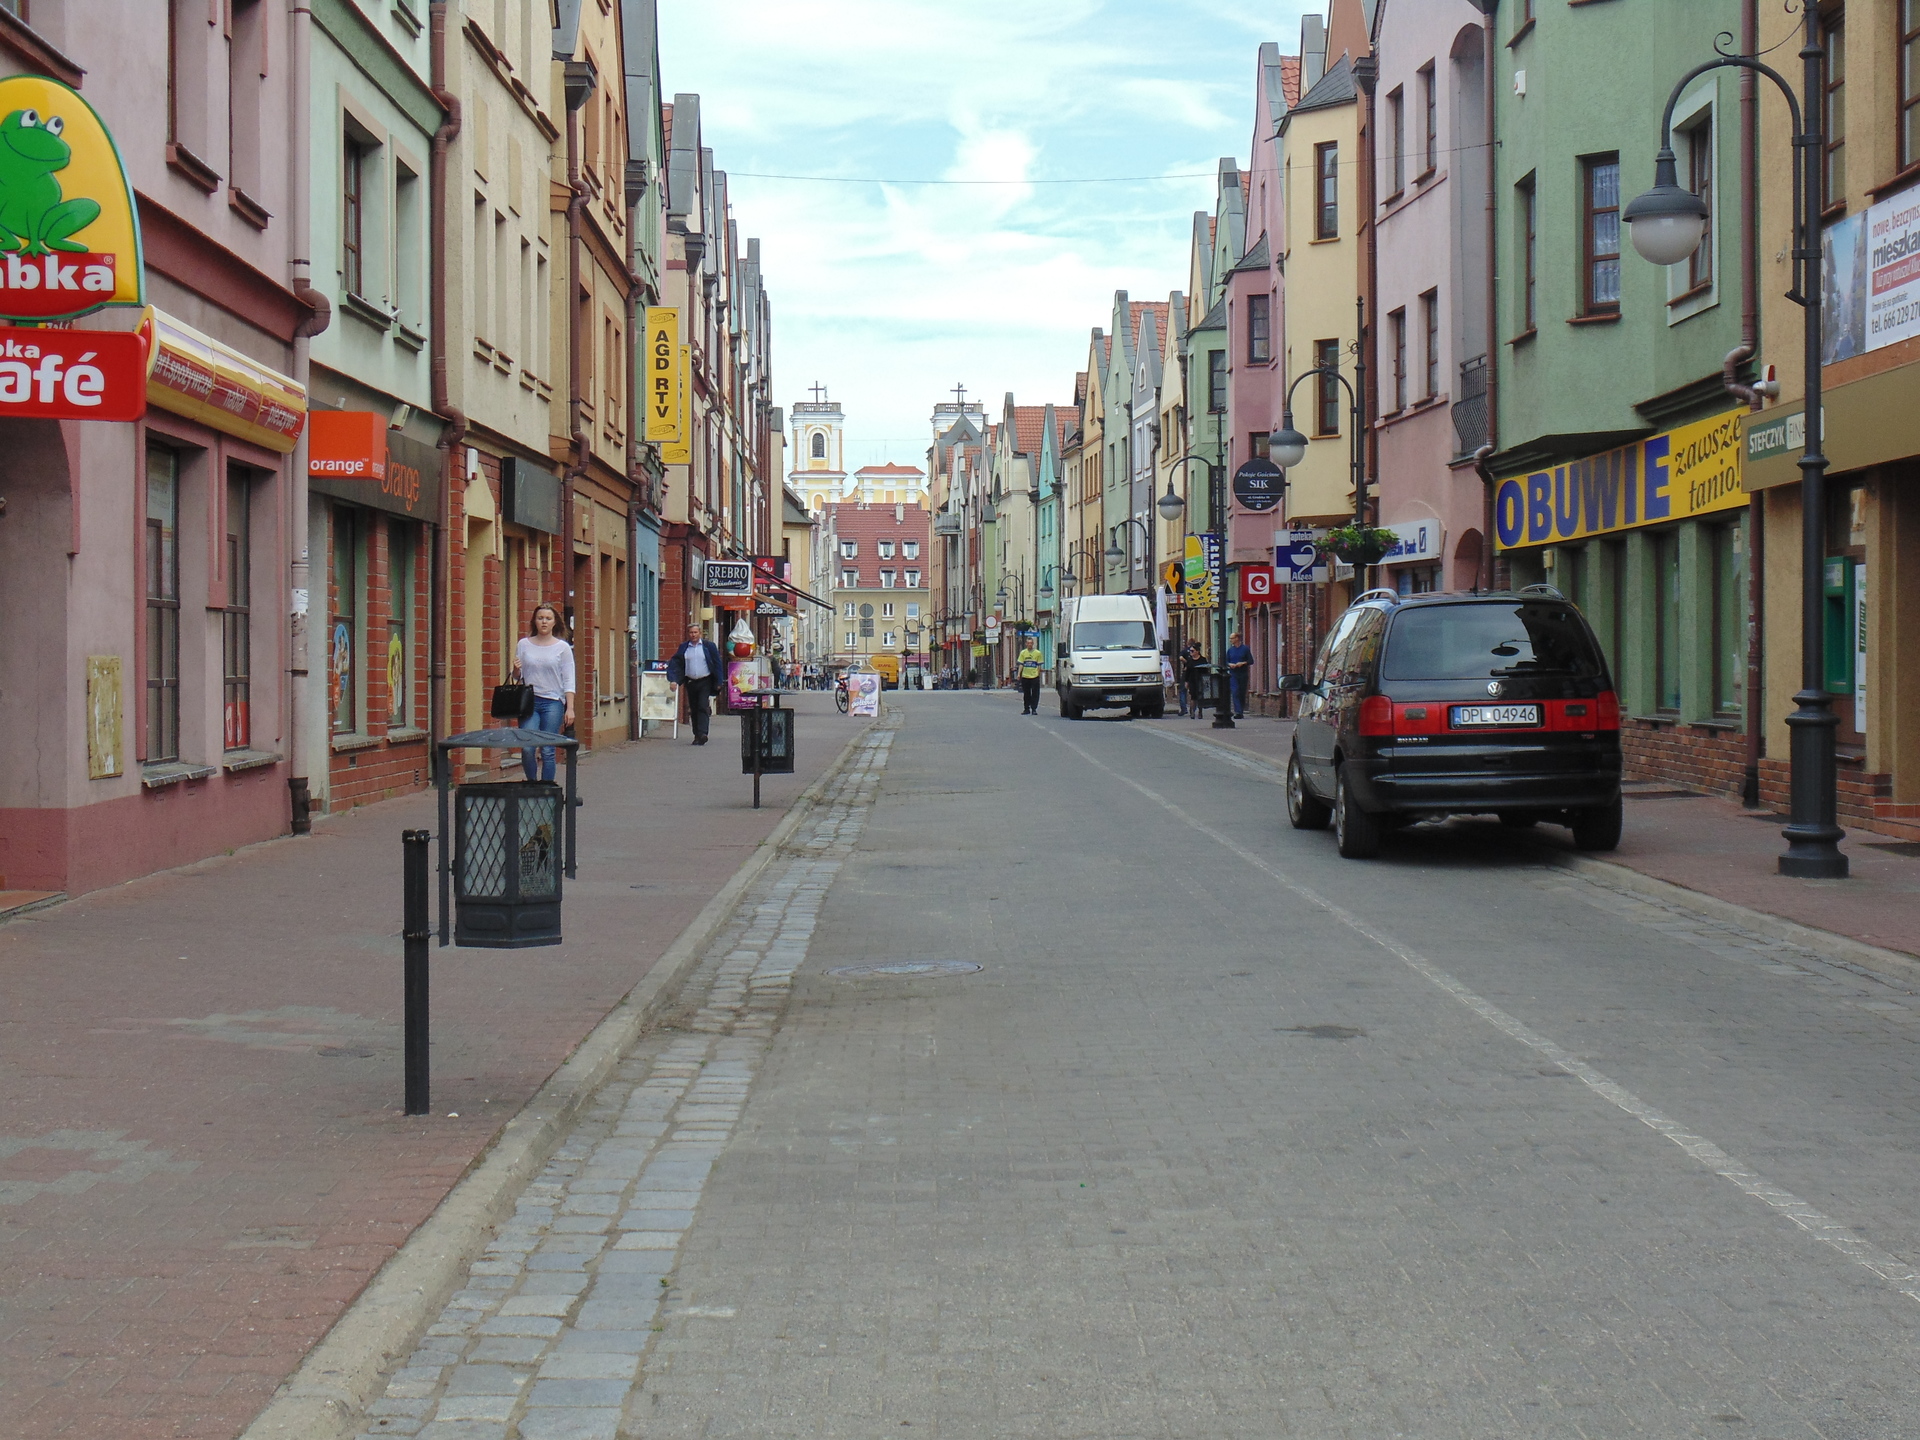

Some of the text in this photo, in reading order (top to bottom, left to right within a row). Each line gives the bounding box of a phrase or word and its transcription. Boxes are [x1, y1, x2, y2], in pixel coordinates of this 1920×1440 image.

[0, 254, 114, 291] bka
[1872, 314, 1882, 334] tel.
[1884, 310, 1895, 330] 666
[1897, 305, 1909, 325] 229
[1675, 414, 1741, 477] zawsze
[1749, 425, 1785, 454] STEFCZYK
[310, 460, 364, 474] orange
[1689, 447, 1741, 512] tanio!
[1497, 435, 1670, 547] OBUWIE
[1291, 533, 1312, 542] apteka
[708, 566, 747, 579] SREBRO
[1462, 707, 1535, 722] DPL 04946
